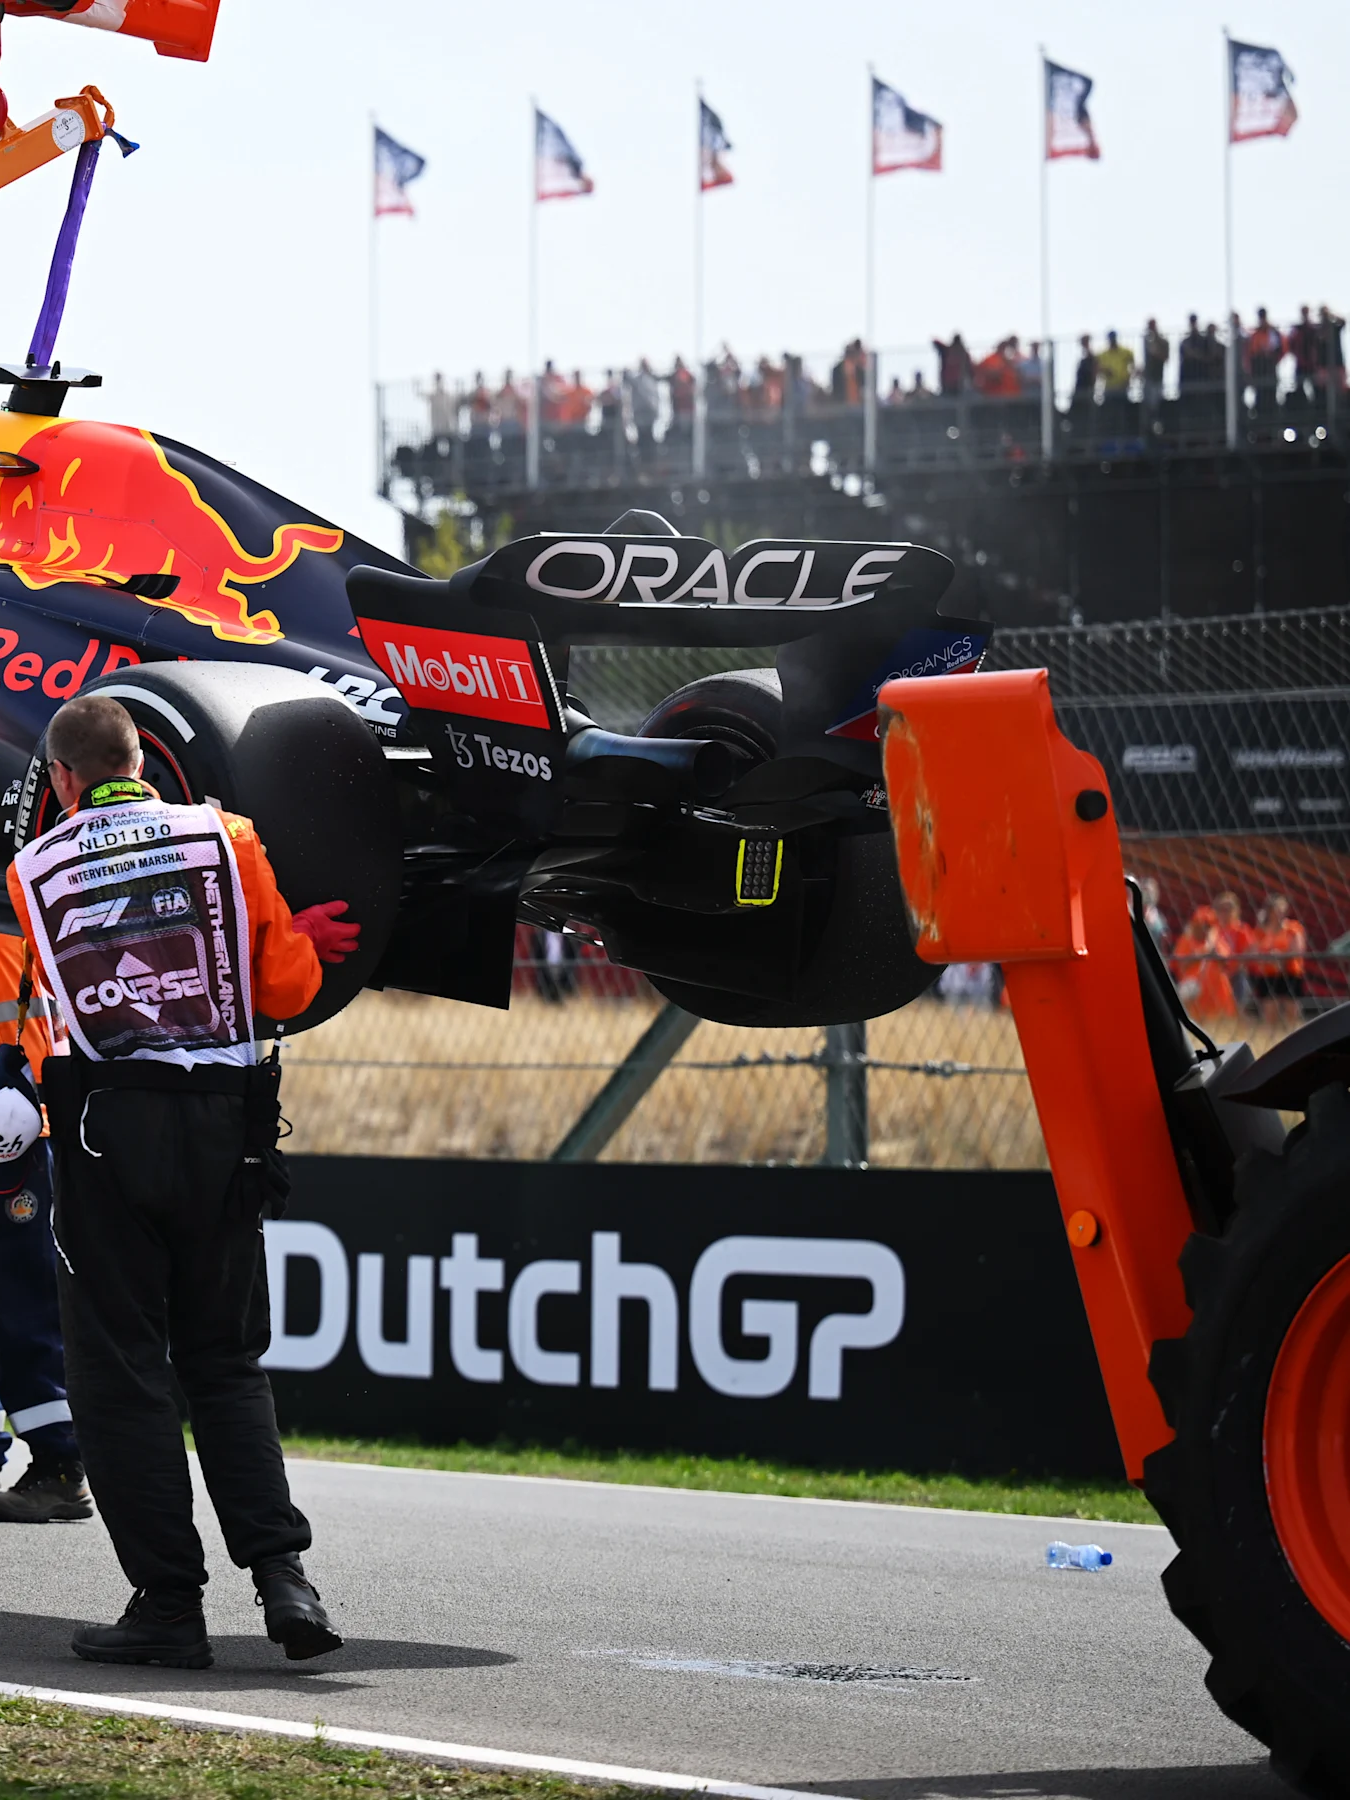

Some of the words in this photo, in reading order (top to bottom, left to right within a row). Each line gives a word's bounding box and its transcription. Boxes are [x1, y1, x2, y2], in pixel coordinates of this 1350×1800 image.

[525, 540, 907, 606] ORACLE
[383, 640, 500, 700] Mobil
[507, 663, 529, 700] 1
[370, 723, 397, 739] ING
[473, 733, 553, 782] Tezos
[87, 816, 111, 832] FIA
[113, 817, 141, 827] World
[128, 810, 164, 819] Formula
[78, 823, 171, 853] NLD1190
[67, 860, 136, 886] INTERVENTION
[138, 851, 188, 869] MARSHAL
[153, 890, 190, 916] FIA
[201, 870, 239, 1043] NETHERLANDS
[75, 967, 205, 1015] COURSE
[259, 1219, 906, 1401] DutchGP
